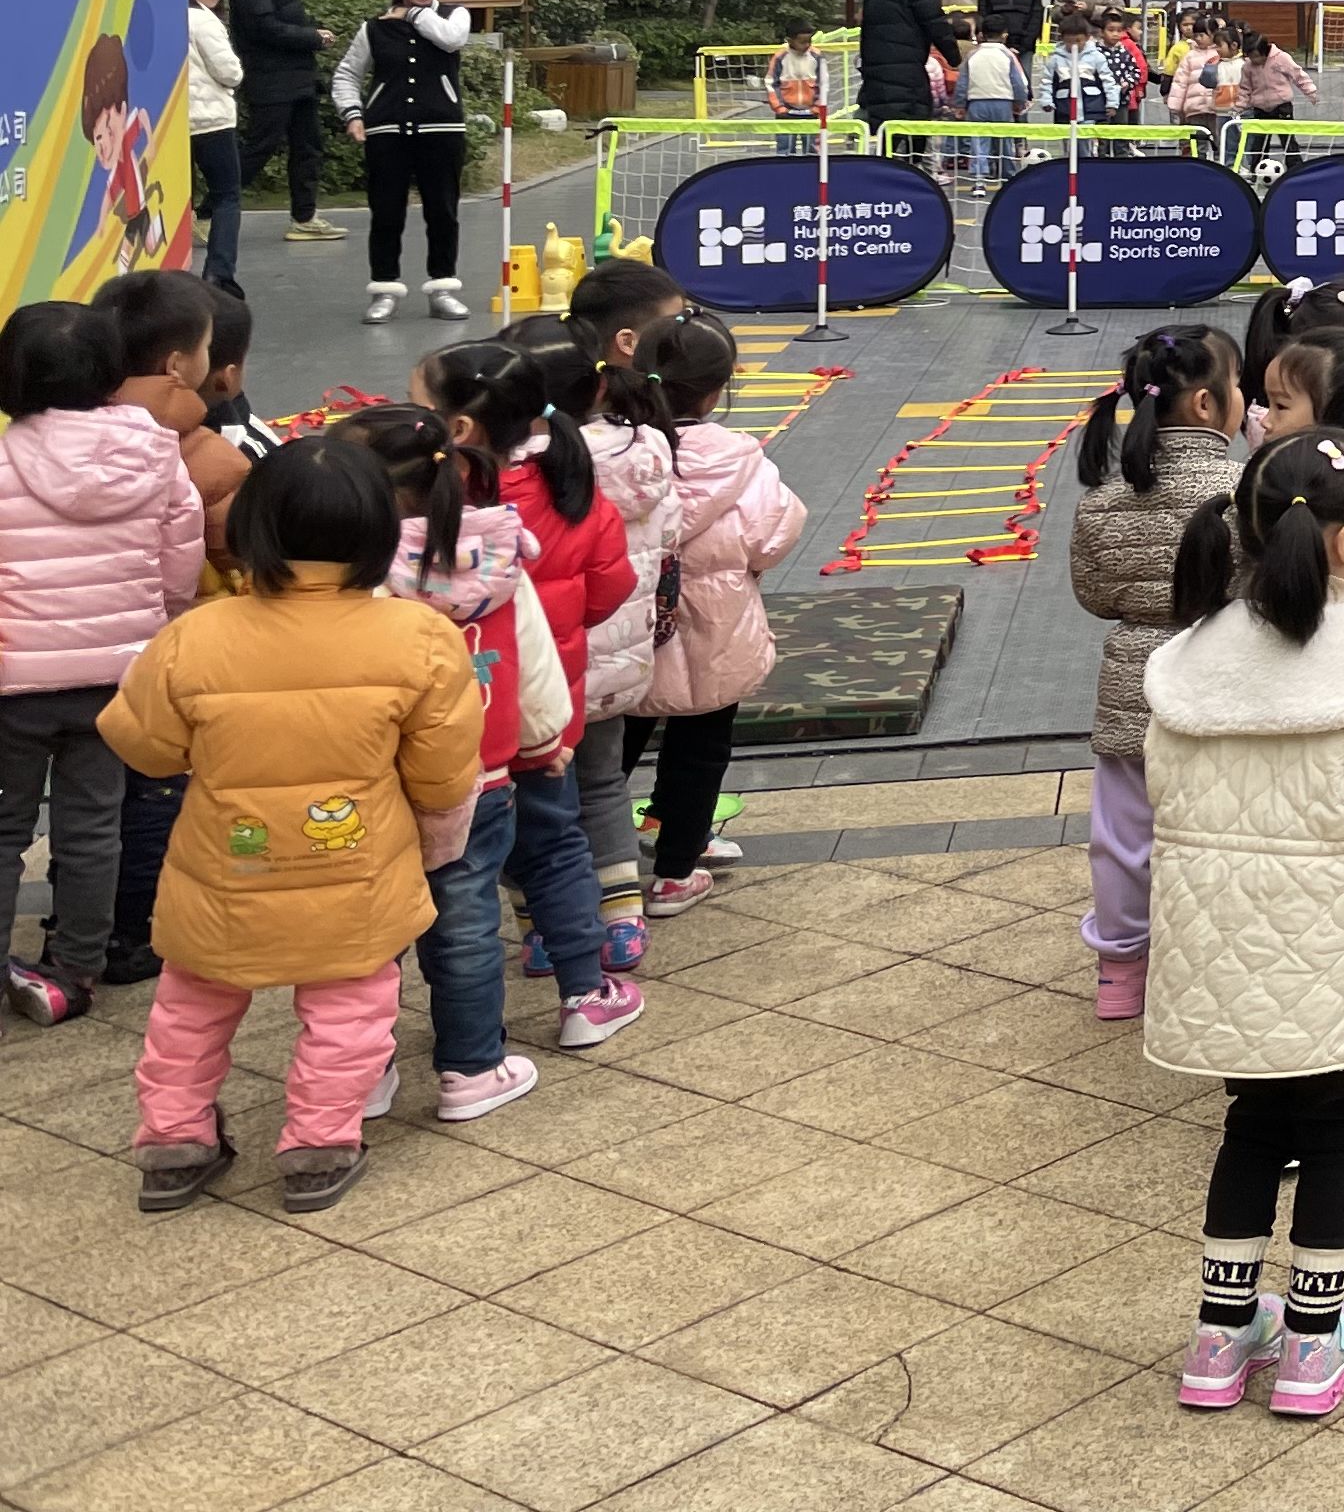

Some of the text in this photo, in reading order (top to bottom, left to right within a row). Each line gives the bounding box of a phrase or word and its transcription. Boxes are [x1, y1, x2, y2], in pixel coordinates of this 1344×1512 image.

[793, 201, 912, 222] 黄龙体育中心
[1110, 204, 1223, 222] 黄龙体育中心
[1110, 225, 1202, 241] Huanglong
[853, 240, 912, 255] Centre
[1109, 243, 1221, 261] Sports Centre
